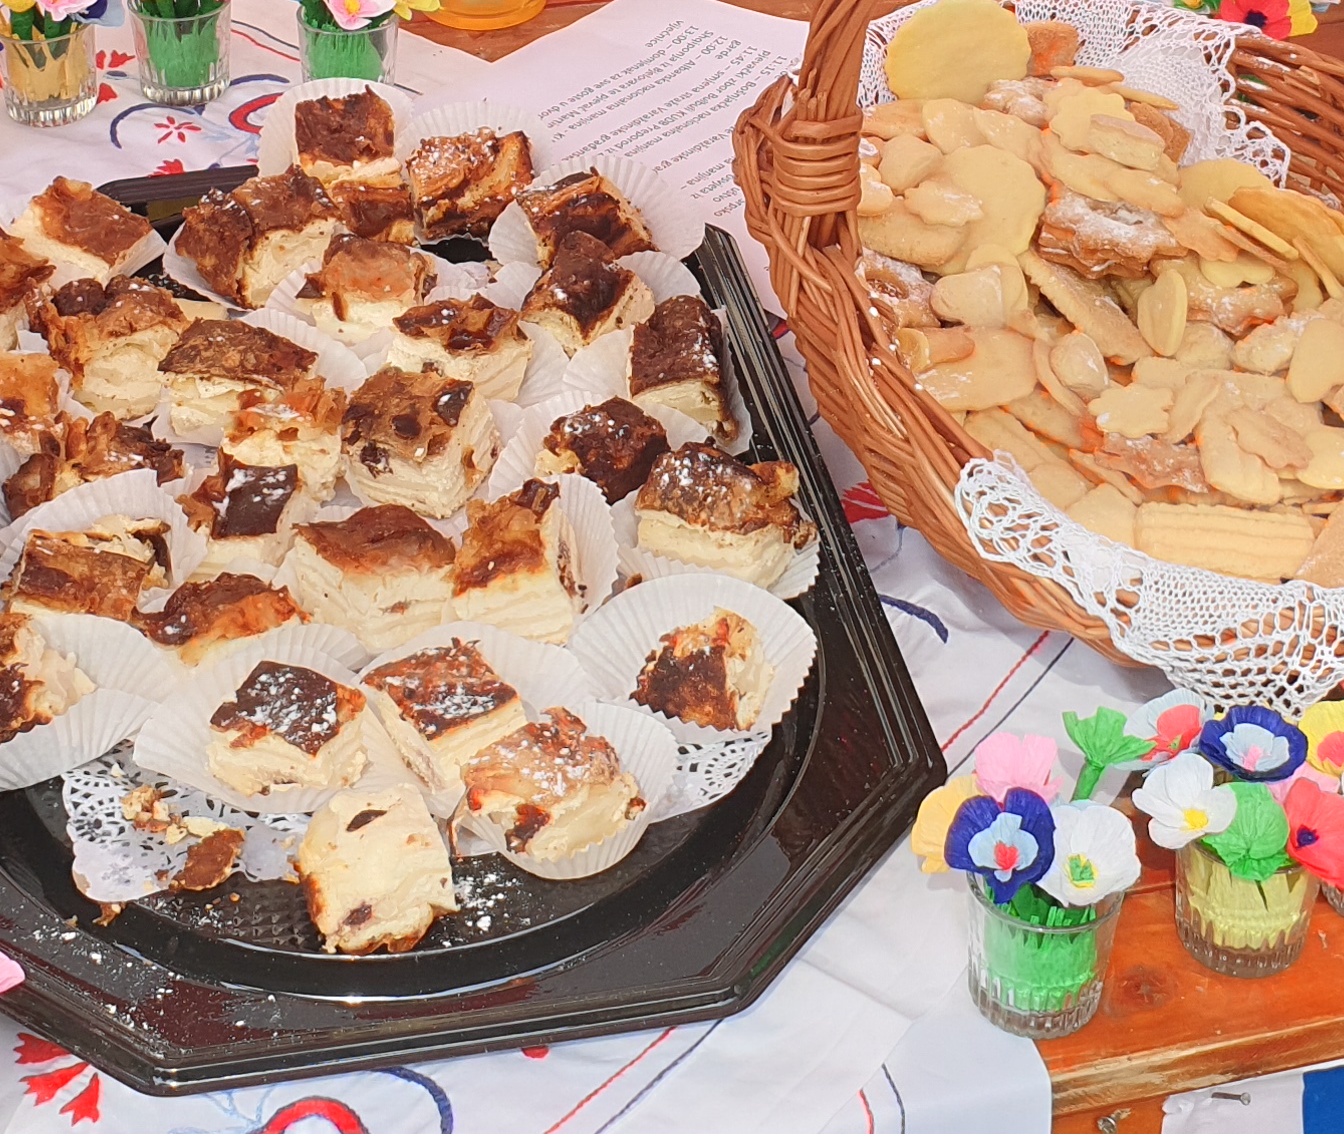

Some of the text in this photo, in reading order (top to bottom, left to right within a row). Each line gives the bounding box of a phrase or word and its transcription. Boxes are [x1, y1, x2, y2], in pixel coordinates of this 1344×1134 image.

[644, 20, 685, 48] vijećnice
[621, 49, 666, 75] domjenak
[714, 39, 742, 60] garde
[592, 78, 612, 89] sve
[654, 59, 696, 85] Albanska
[690, 69, 725, 93] smjena
[567, 86, 595, 103] goste
[709, 80, 757, 112] Bošnjačka
[715, 77, 737, 94] zbor
[609, 106, 669, 136] Varaždinske
[670, 133, 729, 163] Varaždinske
[685, 162, 726, 186] manjina
